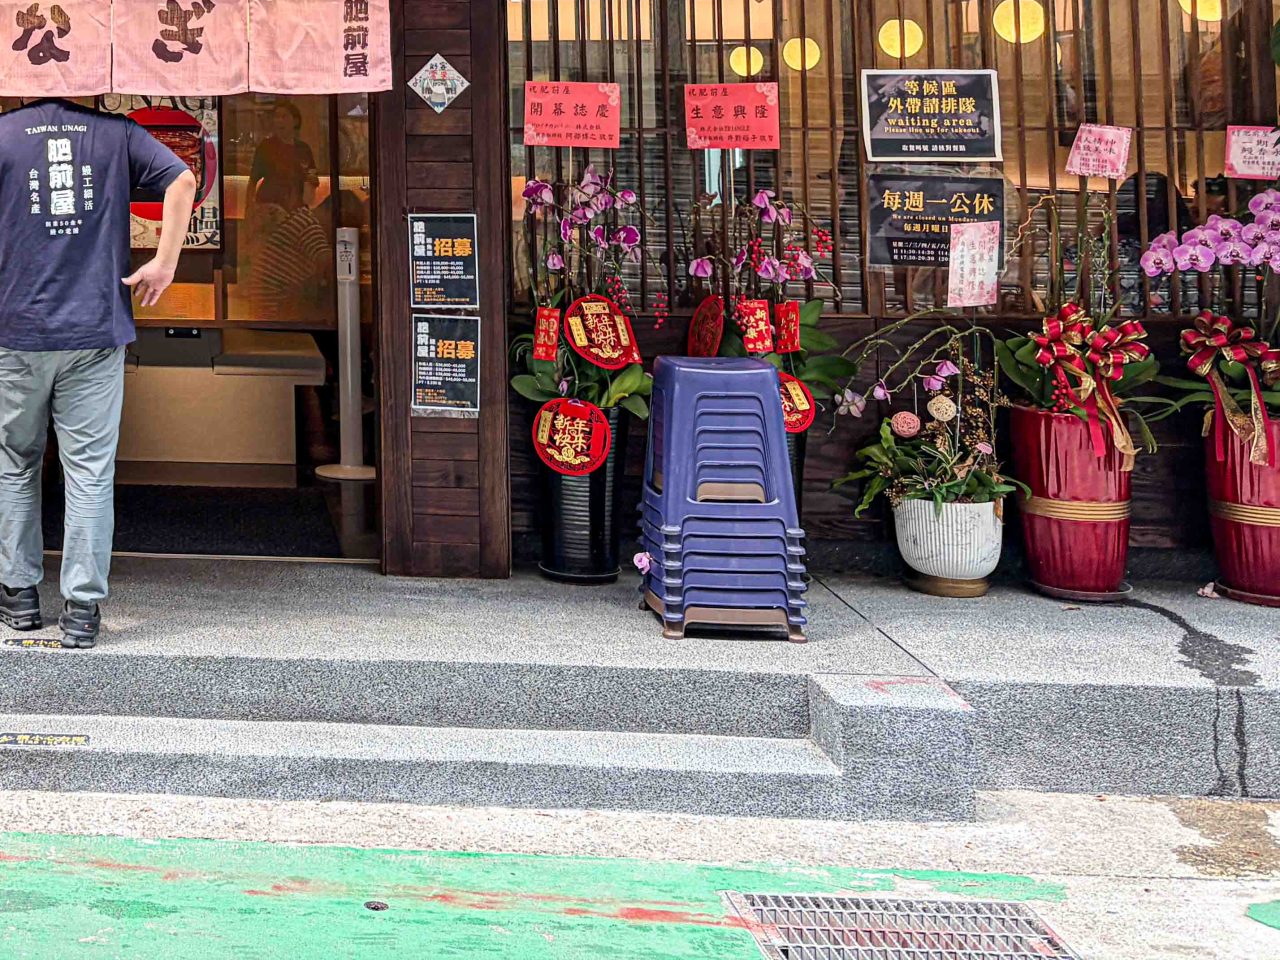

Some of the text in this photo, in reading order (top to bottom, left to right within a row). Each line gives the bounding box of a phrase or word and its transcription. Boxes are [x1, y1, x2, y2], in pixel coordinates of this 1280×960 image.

[904, 80, 957, 96] 等候區
[530, 102, 609, 118] 開幕誌慶
[691, 104, 769, 119] 生意興隆
[887, 97, 977, 114] 外帶請排隊
[25, 124, 87, 135] TAIWAN UNAGI
[887, 116, 973, 128] waiting area
[925, 127, 935, 135] up
[47, 138, 76, 215] 肥前屋
[881, 189, 995, 215] 每週一公休
[433, 238, 473, 257] 招募
[437, 339, 476, 359] 招募
